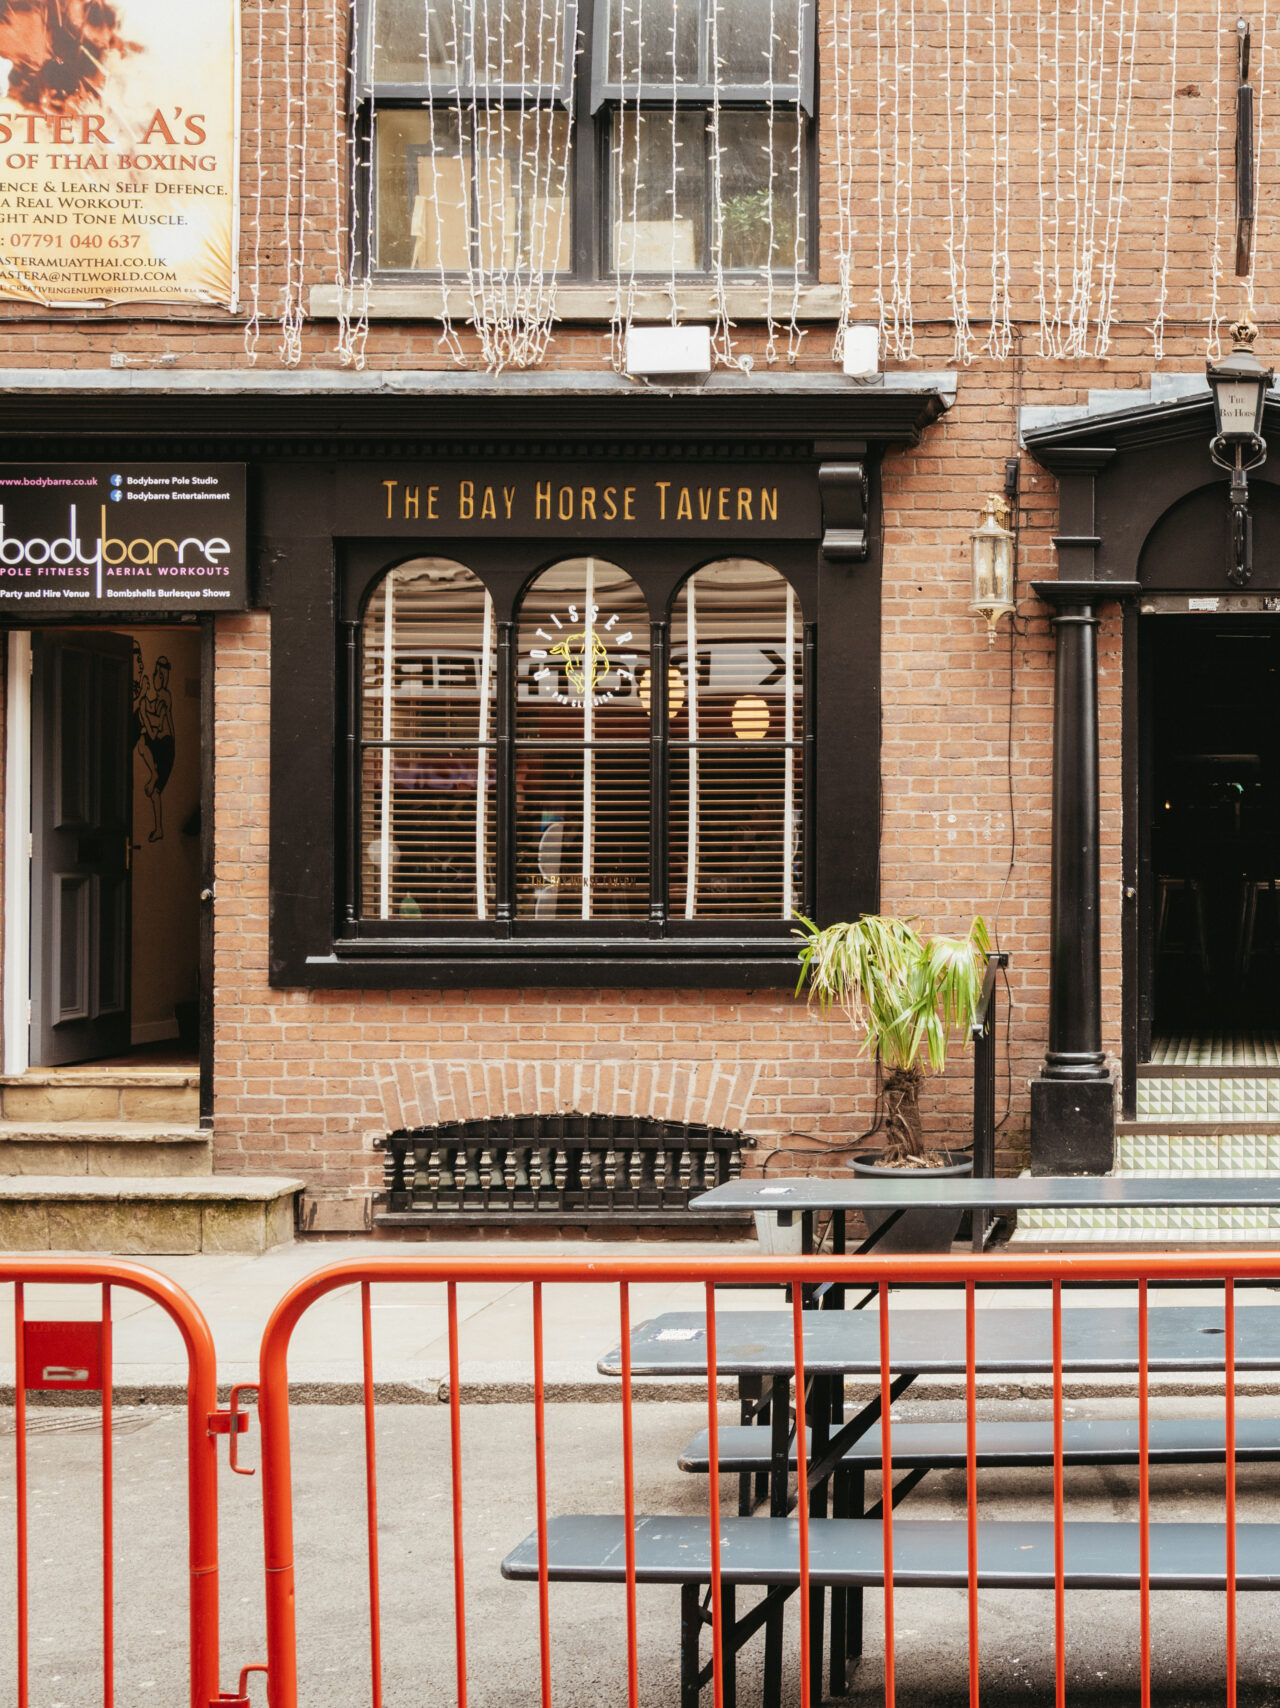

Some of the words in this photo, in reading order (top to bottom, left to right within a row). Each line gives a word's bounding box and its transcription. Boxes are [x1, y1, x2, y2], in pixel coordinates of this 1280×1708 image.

[136, 106, 207, 145] A'S
[6, 153, 39, 170] OF
[46, 153, 109, 170] THAI
[117, 153, 217, 172] BOXING
[43, 181, 57, 193] &
[61, 182, 110, 193] LEARN
[116, 182, 149, 194] SELF
[155, 183, 228, 196] DEFENCE.
[16, 197, 53, 208] REAL
[57, 197, 143, 209] WORKOUT.
[33, 214, 68, 225] AND
[72, 213, 117, 225] TONE
[122, 213, 188, 226] MUSCLE.
[10, 233, 63, 249] 07791
[69, 234, 103, 249] 040
[108, 234, 141, 249] 637
[127, 476, 170, 486] Bodybarre
[171, 476, 190, 485] Pole
[191, 476, 219, 485] Studio
[127, 491, 170, 502] Bodybarre
[171, 491, 230, 500] Entertainment
[382, 480, 440, 520] THE
[458, 480, 516, 520] BAY
[535, 480, 637, 521] HORSE
[655, 481, 779, 521] TAVERN
[0, 567, 32, 576] POLE
[37, 567, 90, 576] FITNESS
[106, 567, 152, 576] AERIAL
[158, 567, 230, 576] WORKOUTS
[0, 589, 22, 600] Party
[24, 590, 41, 598] and
[42, 589, 61, 598] Hire
[62, 589, 90, 598] Venue
[106, 589, 156, 598] Bombshells
[157, 588, 201, 600] Burlesque
[202, 588, 231, 598] Shows
